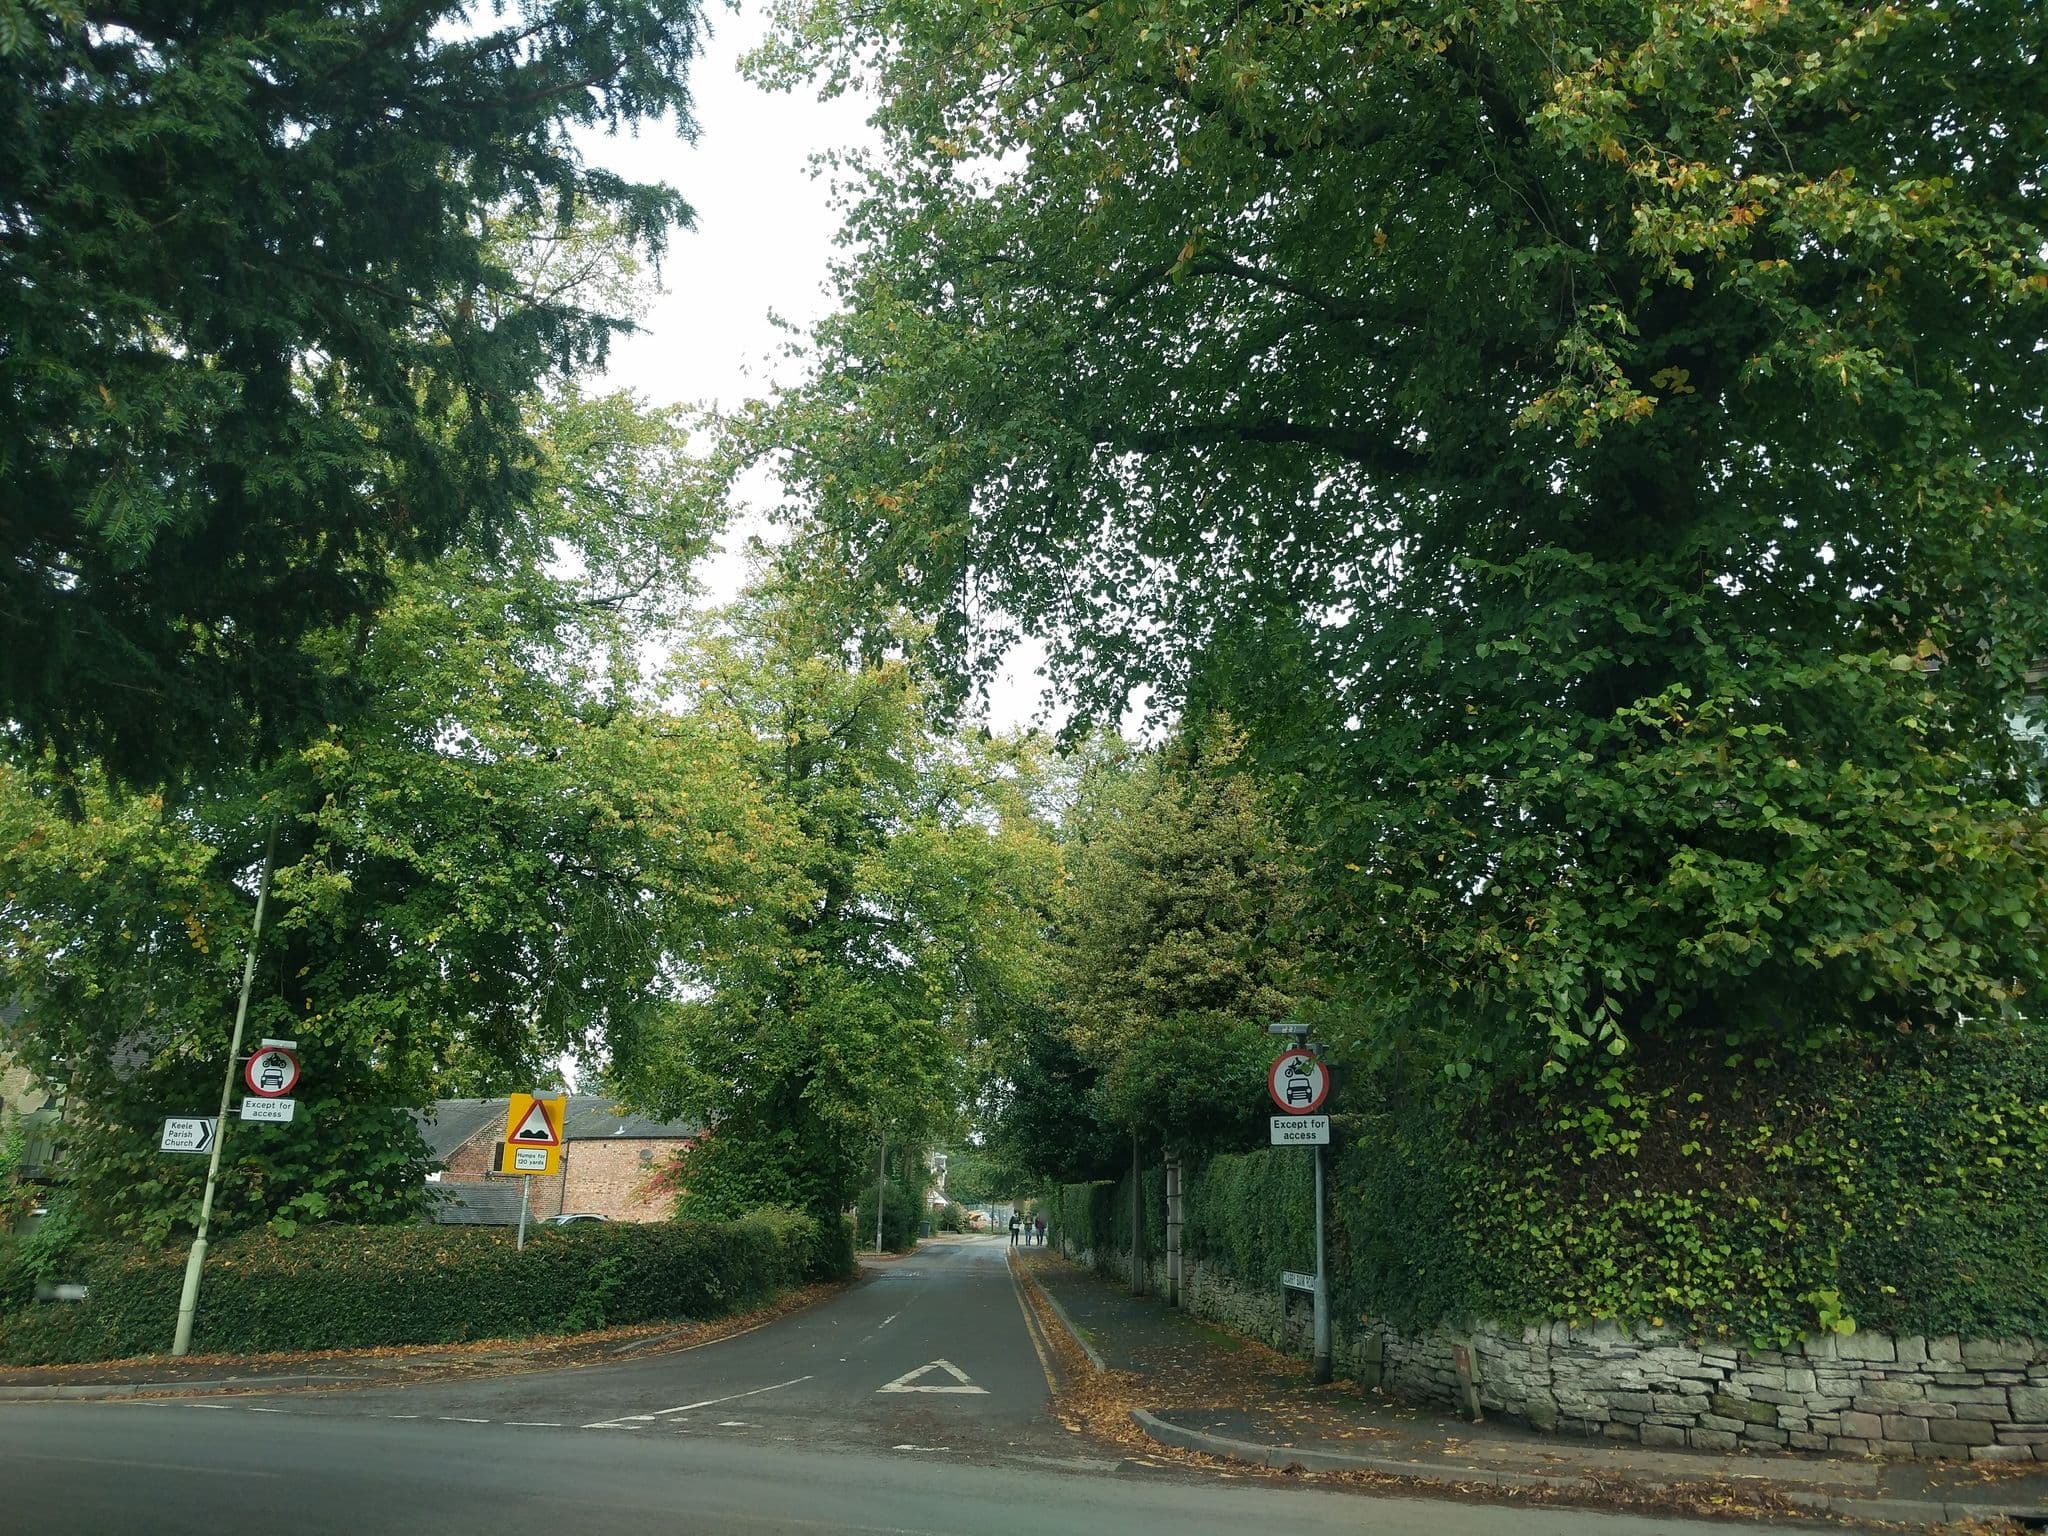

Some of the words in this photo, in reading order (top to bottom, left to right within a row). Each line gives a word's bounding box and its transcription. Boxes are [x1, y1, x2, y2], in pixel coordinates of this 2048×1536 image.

[245, 1100, 275, 1110] Except
[279, 1102, 292, 1110] for
[171, 1122, 193, 1130] Keele
[1274, 1119, 1308, 1130] Except
[1311, 1119, 1325, 1129] for
[168, 1130, 193, 1138] Parish
[1283, 1131, 1317, 1140] access
[164, 1139, 193, 1147] Church
